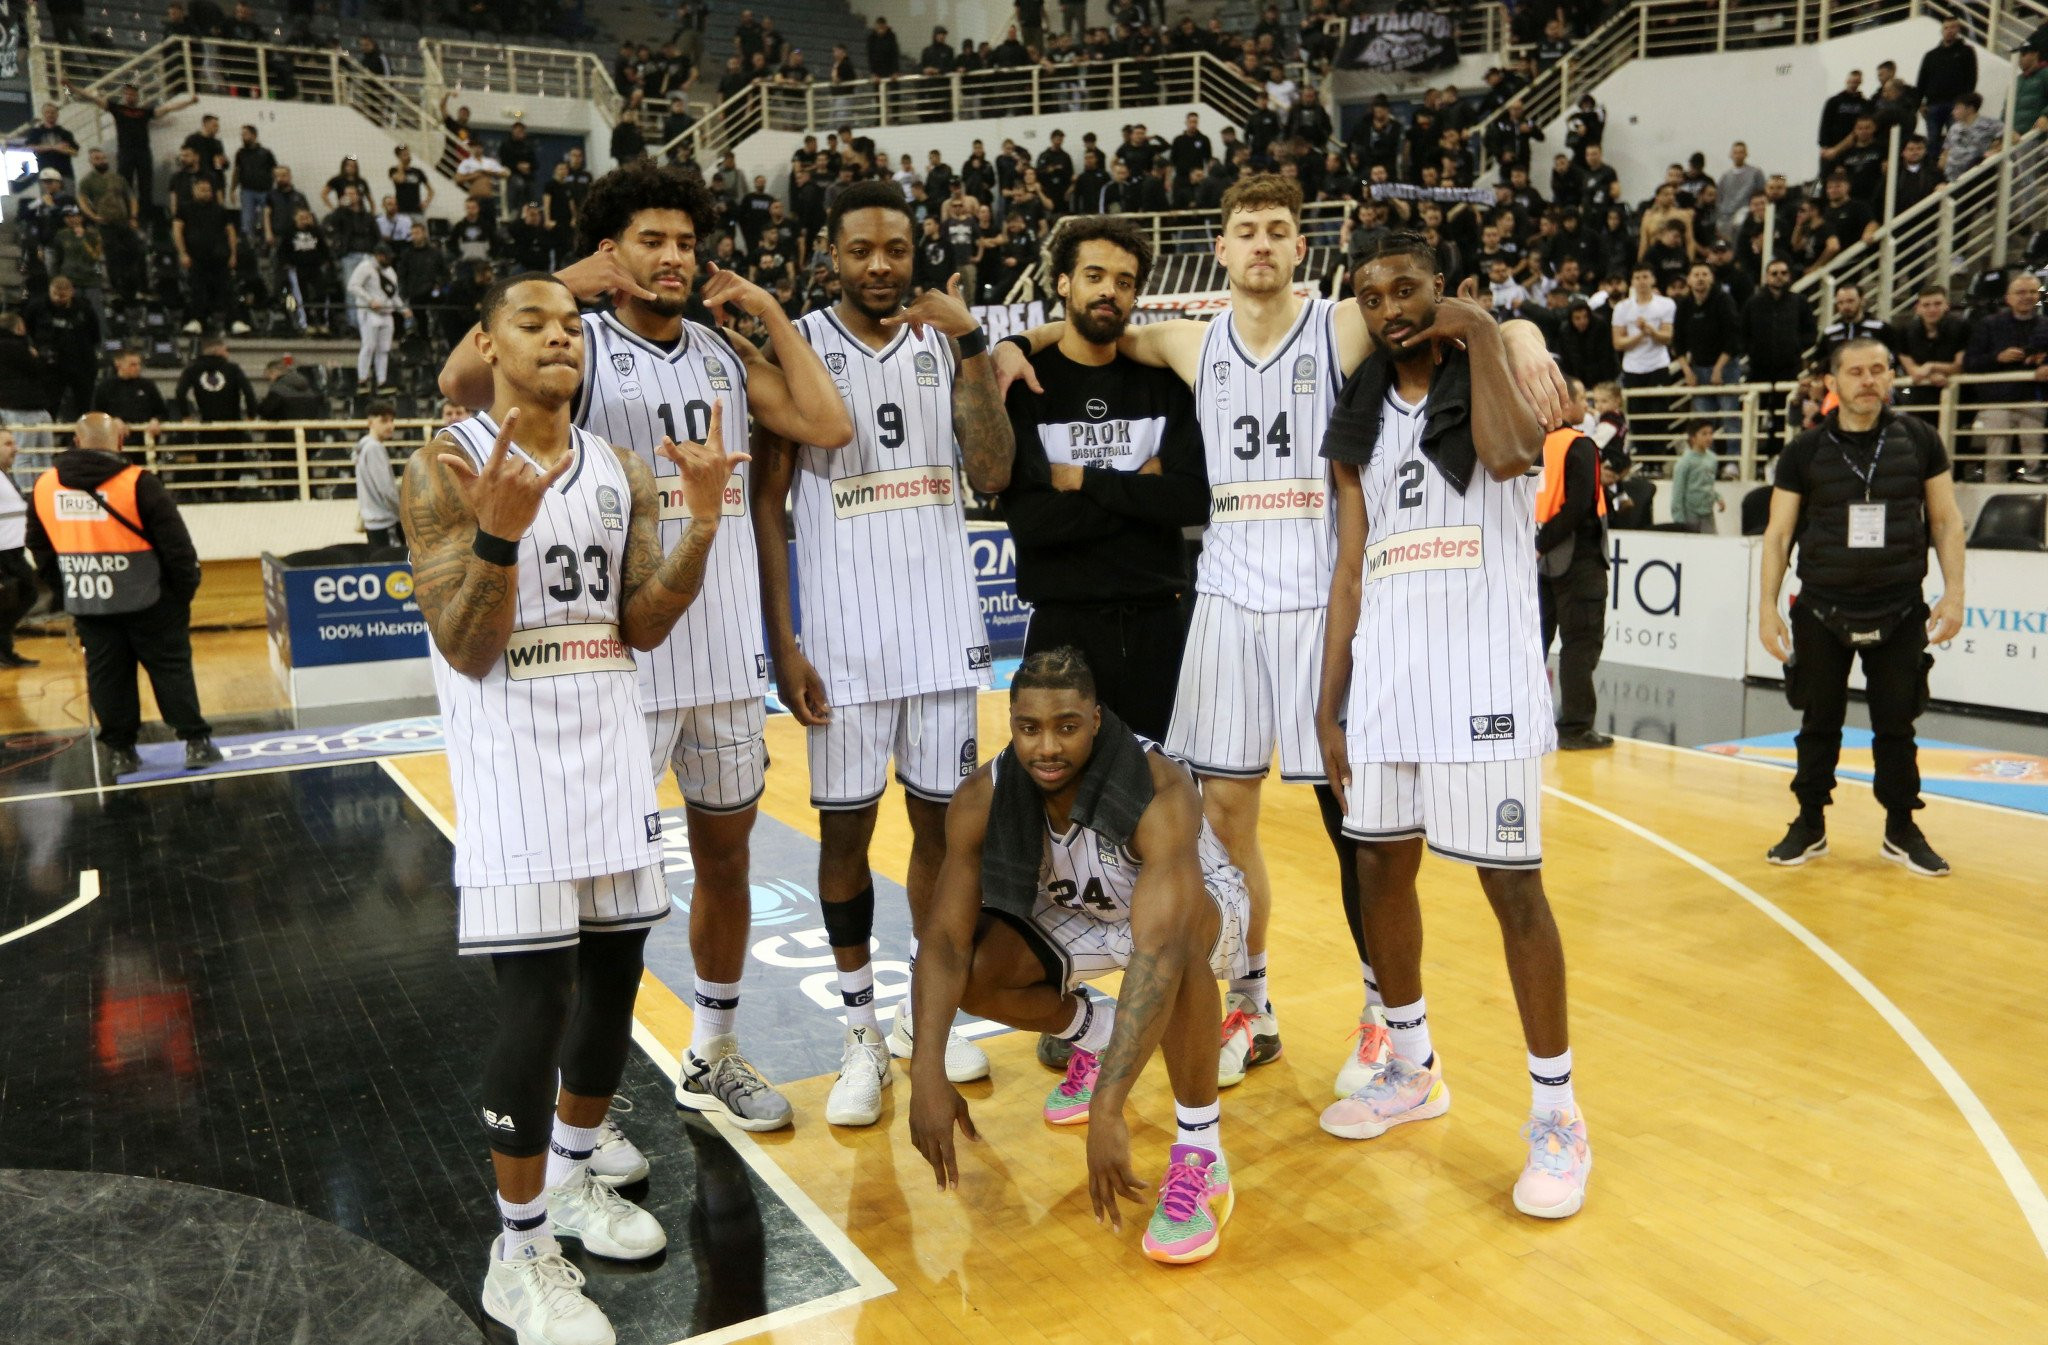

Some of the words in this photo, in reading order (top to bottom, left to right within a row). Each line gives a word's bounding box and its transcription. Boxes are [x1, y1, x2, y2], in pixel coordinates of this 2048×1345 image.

[917, 377, 938, 386] GBL
[1293, 384, 1315, 393] GBL
[657, 400, 712, 447] 10
[877, 403, 905, 449] 9
[1068, 420, 1131, 447] PAOK
[1233, 411, 1291, 461] 34
[1071, 445, 1133, 460] BASKETBALL
[836, 475, 951, 508] winmasters
[1399, 460, 1424, 509] 2
[1215, 488, 1325, 513] winmasters
[603, 518, 622, 529] GBL
[64, 573, 114, 600] 200
[545, 544, 610, 602] 33
[313, 573, 382, 604] eco
[319, 622, 364, 641] 100%
[1498, 831, 1523, 842] GBL
[1047, 876, 1118, 911] 24
